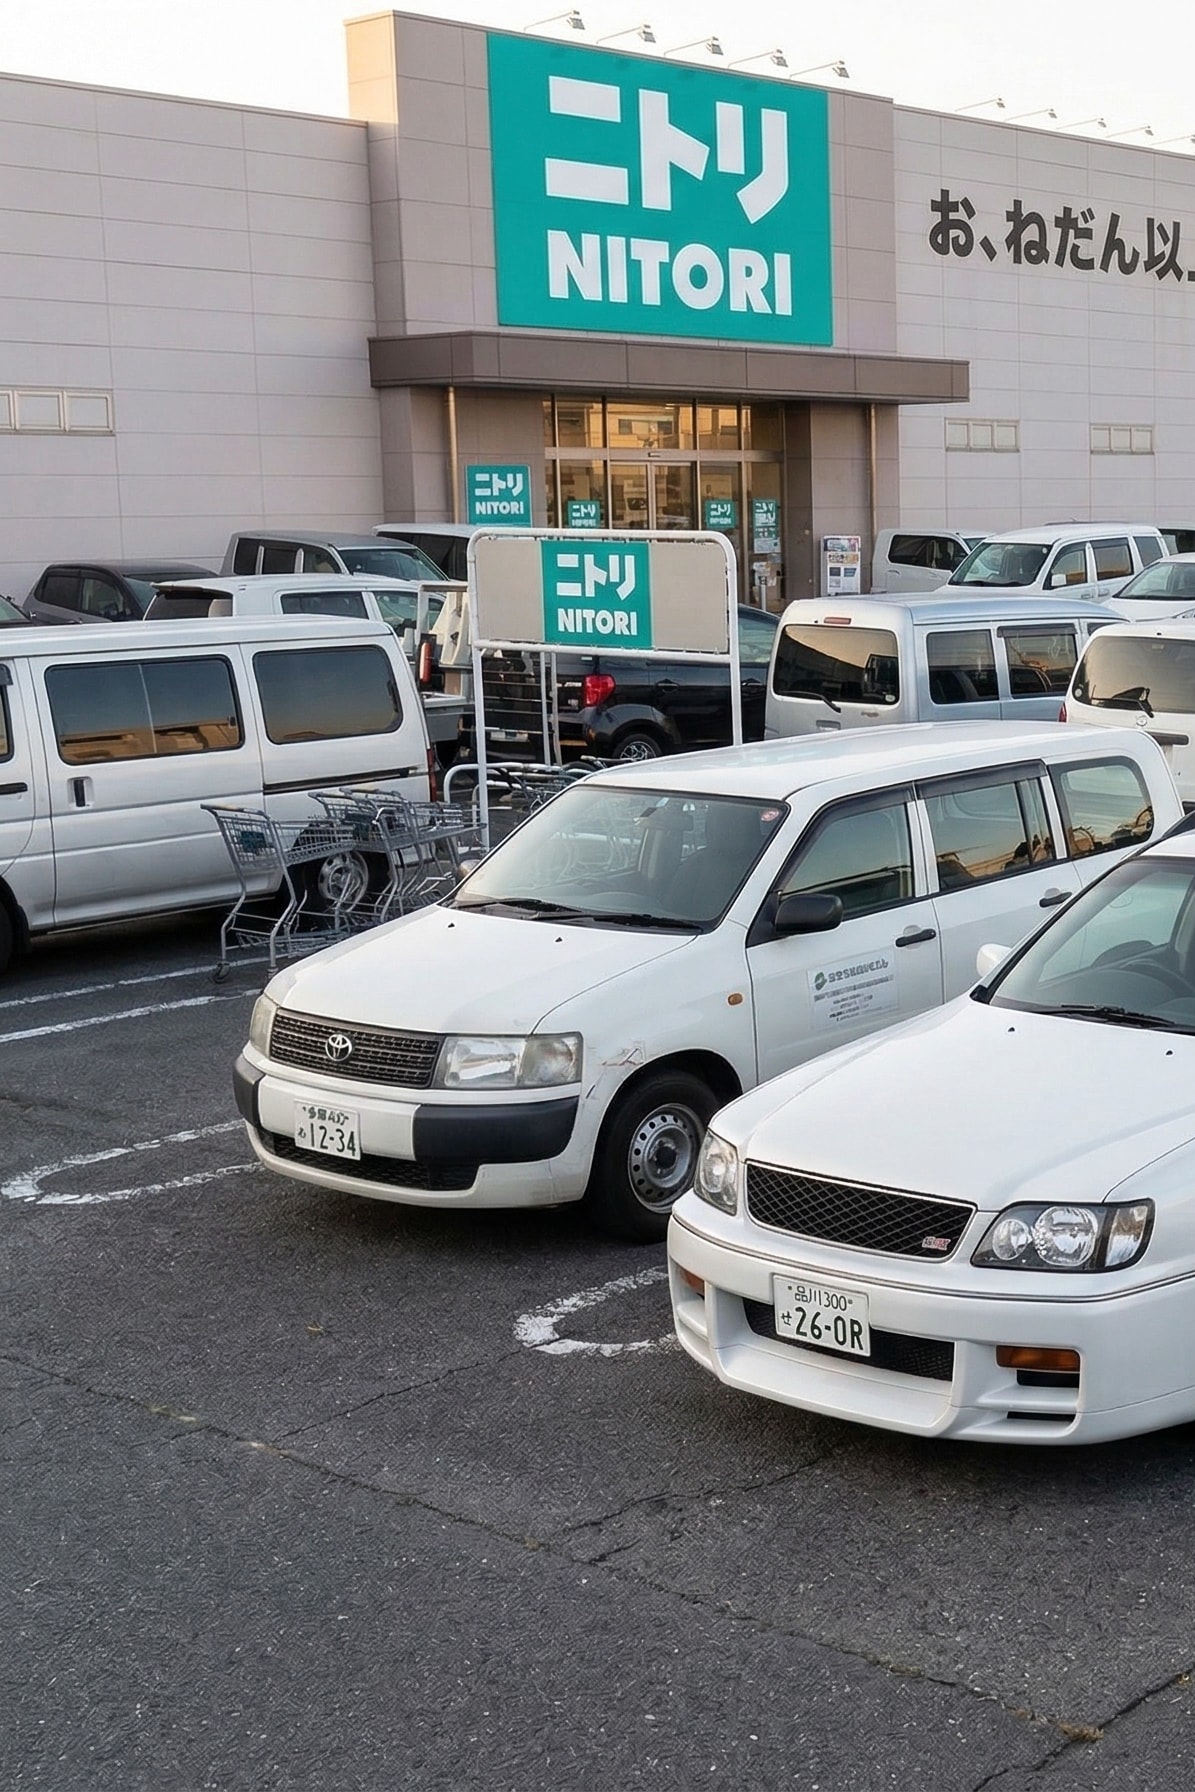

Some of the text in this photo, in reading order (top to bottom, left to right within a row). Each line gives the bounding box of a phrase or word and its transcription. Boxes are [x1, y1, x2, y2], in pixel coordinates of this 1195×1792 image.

[546, 75, 789, 224] ニトリ
[547, 230, 792, 316] NITORI
[475, 474, 523, 497] ニトリ
[475, 501, 524, 515] NITORI
[557, 554, 635, 600] ニトリ
[558, 608, 638, 635] NITORI
[310, 1122, 356, 1157] 12-34
